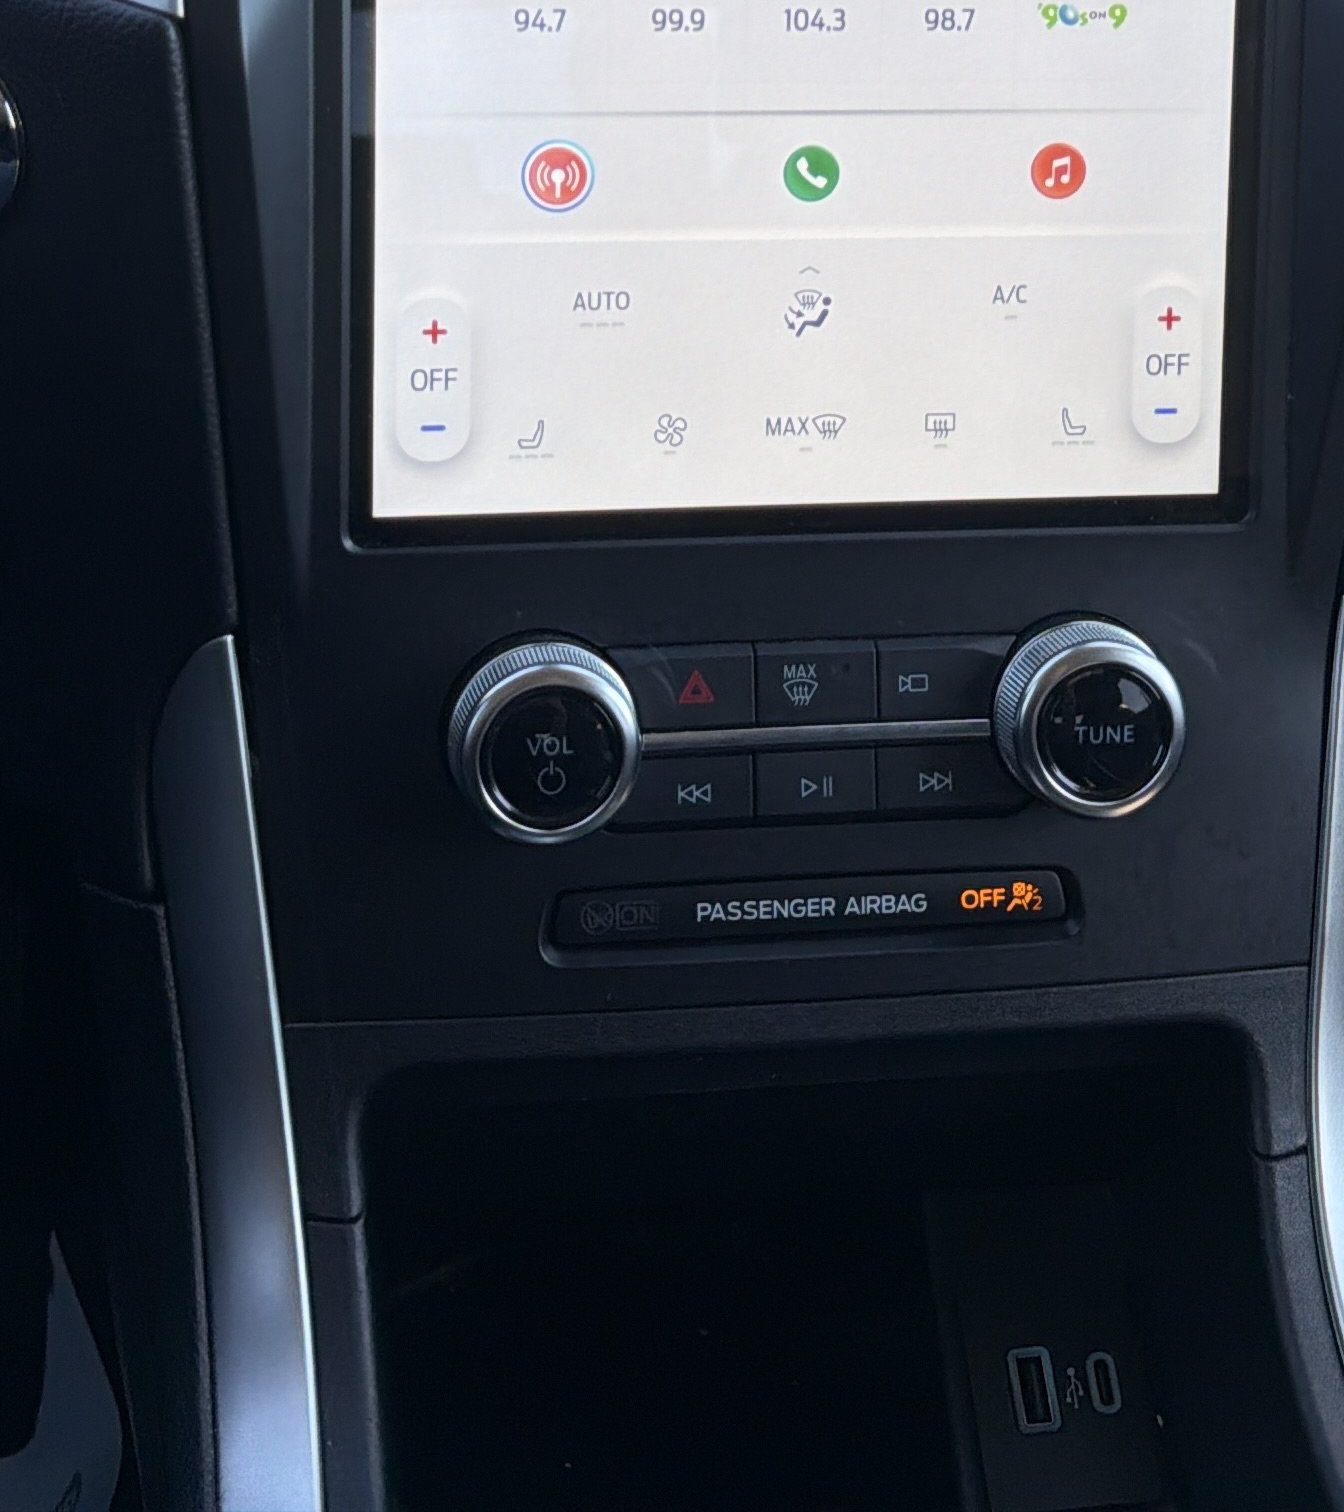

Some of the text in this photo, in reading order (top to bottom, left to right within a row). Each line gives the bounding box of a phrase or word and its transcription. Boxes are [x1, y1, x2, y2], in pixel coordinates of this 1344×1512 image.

[515, 9, 566, 32] 94.7
[652, 9, 705, 31] 99.9
[785, 9, 845, 31] 104.3
[925, 9, 975, 31] 98.7
[1089, 11, 1106, 19] ON
[1108, 3, 1127, 29] 9
[573, 291, 630, 311] AUTO
[993, 285, 1027, 304] A/C
[1146, 354, 1189, 375] OFF
[411, 368, 457, 391] OFF
[766, 417, 809, 436] MAX
[783, 663, 817, 680] MAX
[1074, 724, 1136, 745] TUNE
[526, 735, 575, 757] VOL
[697, 894, 927, 922] PASSENGER AIRBAG
[960, 888, 1006, 909] OFF
